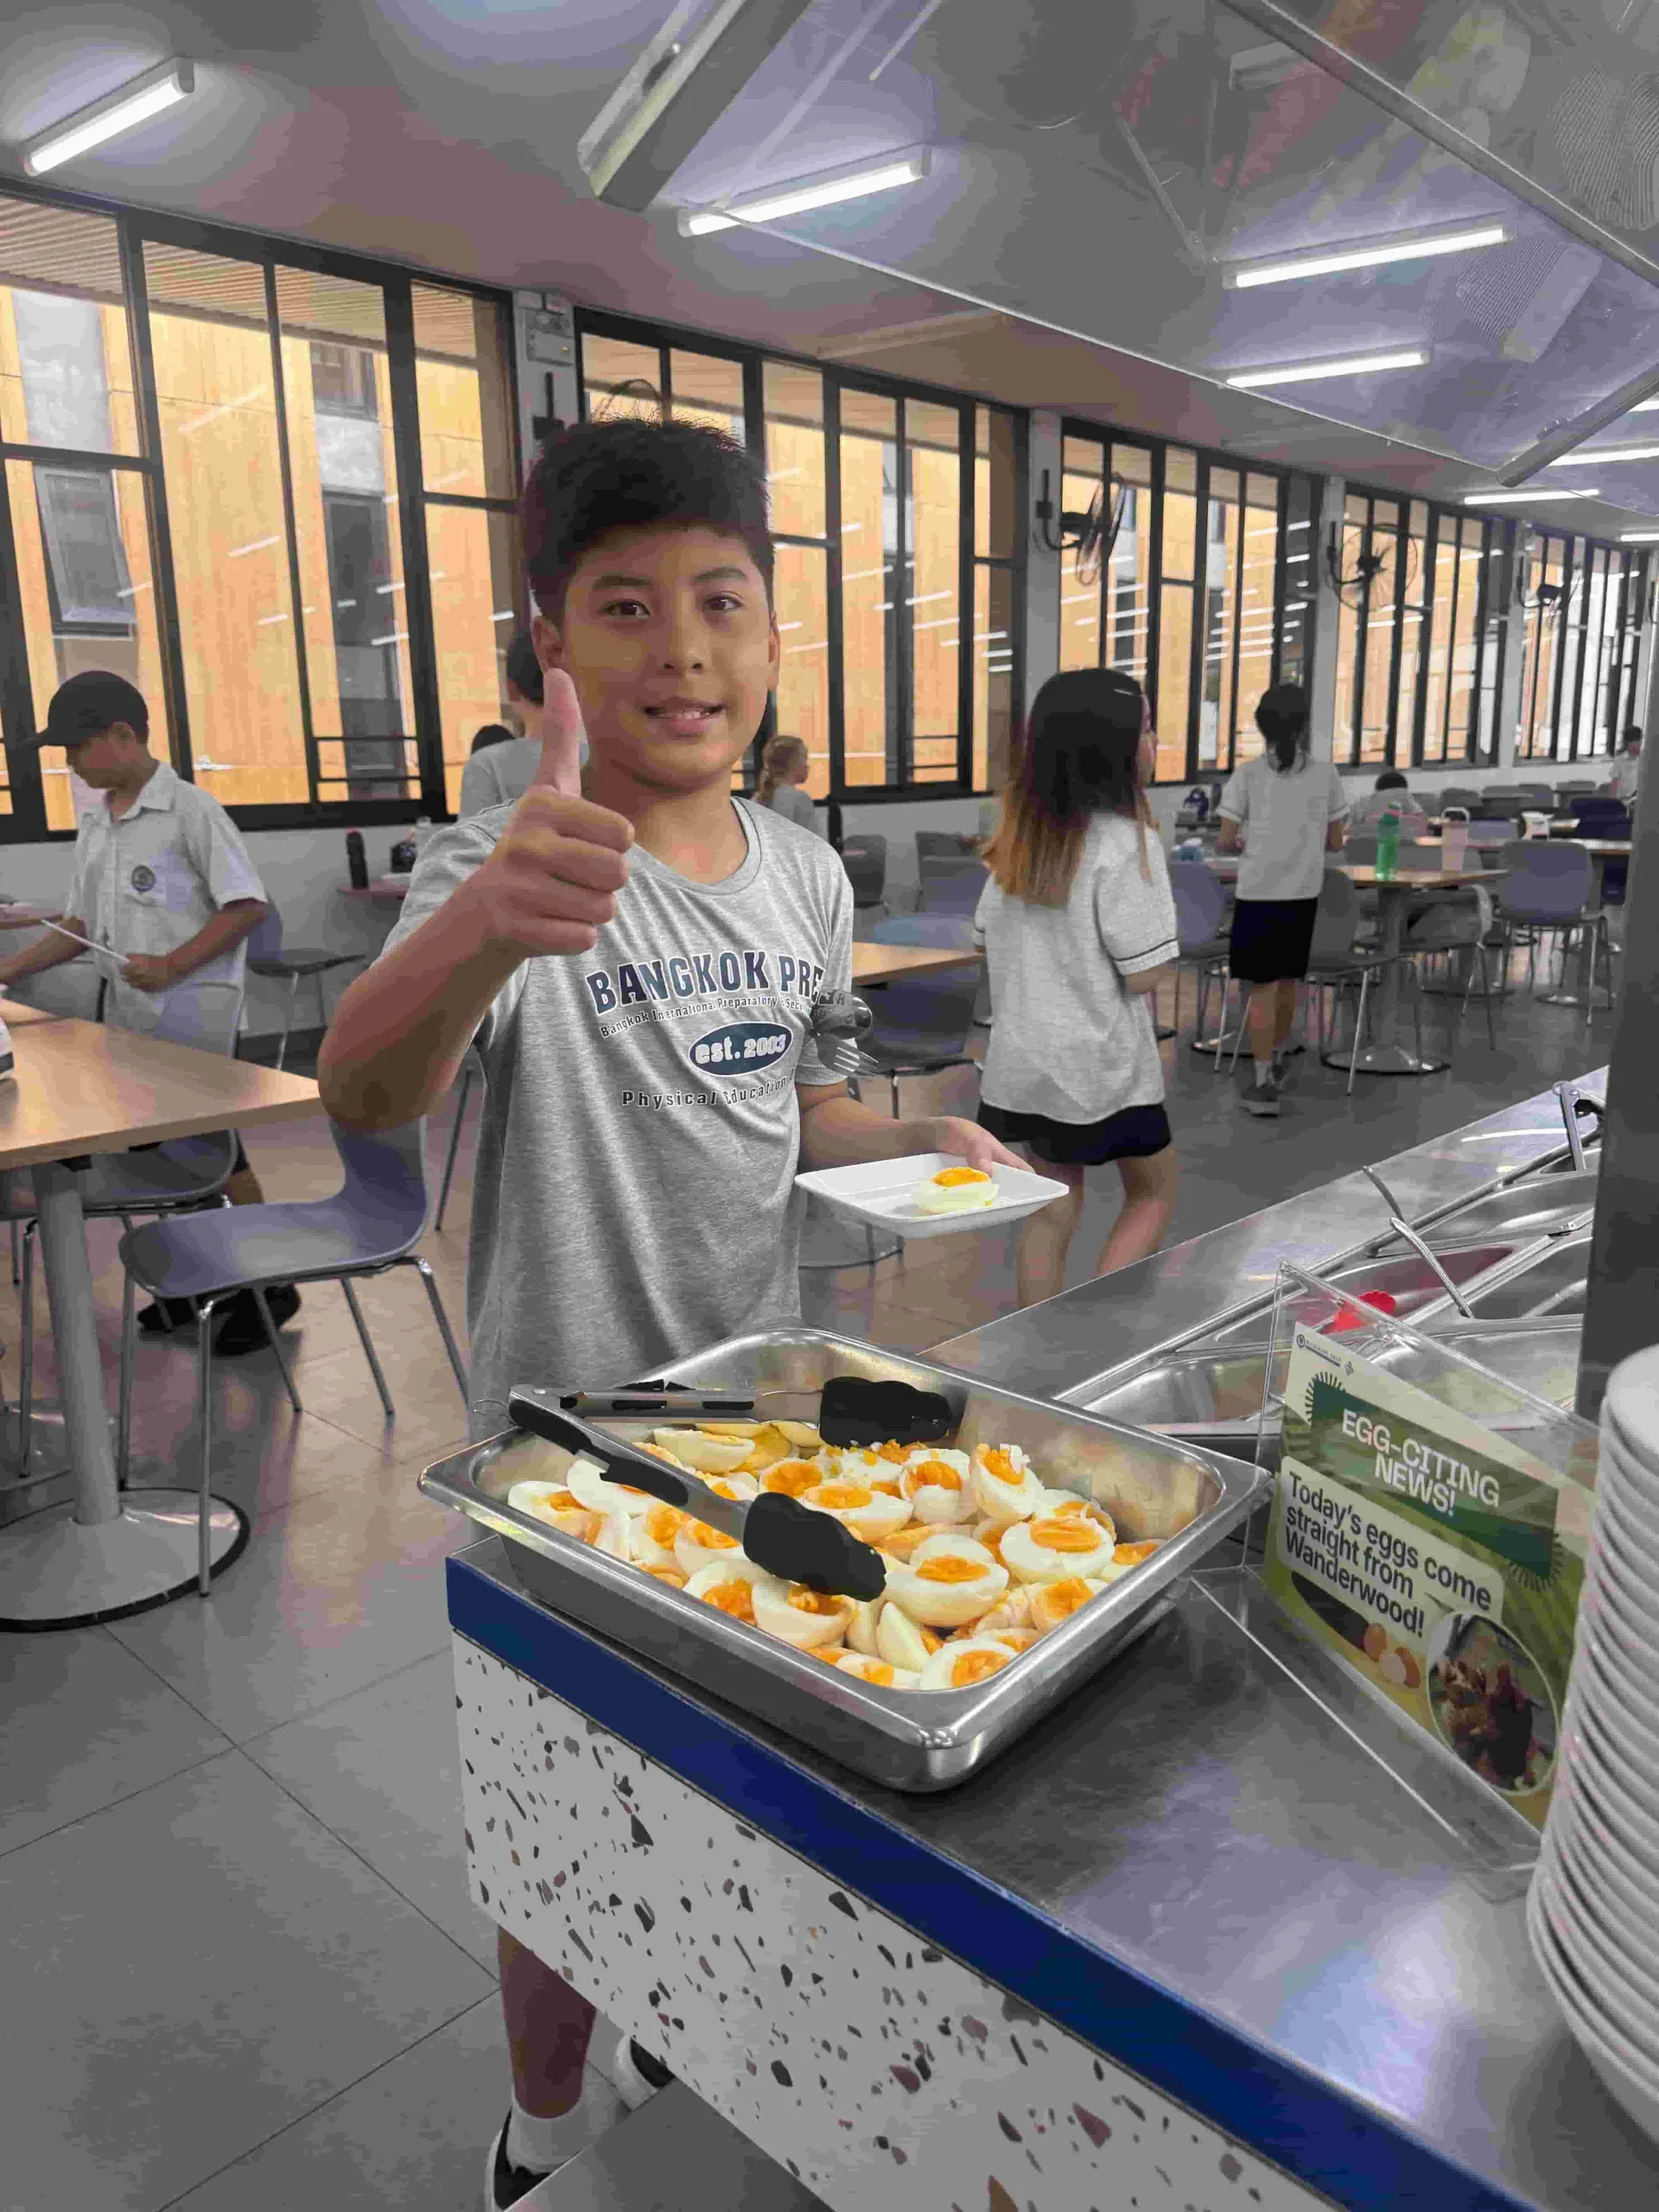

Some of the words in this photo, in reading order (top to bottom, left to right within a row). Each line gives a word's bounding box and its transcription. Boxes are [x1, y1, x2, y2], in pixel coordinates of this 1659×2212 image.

[585, 950, 770, 1016] BANGKOK
[600, 1011, 650, 1039] Bangkok
[717, 996, 777, 1010] Preparatory
[695, 1036, 741, 1065] est.
[743, 1033, 786, 1058] 2003
[621, 1090, 717, 1112] Physical
[723, 1077, 787, 1105] Education
[1342, 1408, 1500, 1508] EGG-CITING
[1374, 1452, 1457, 1517] NEWS!
[1286, 1505, 1360, 1567] straight
[1363, 1547, 1414, 1599] from
[1288, 1470, 1362, 1535] Today's
[1365, 1522, 1419, 1569] eggs
[1424, 1556, 1492, 1611] come
[1285, 1527, 1425, 1638] Wanderwood!
